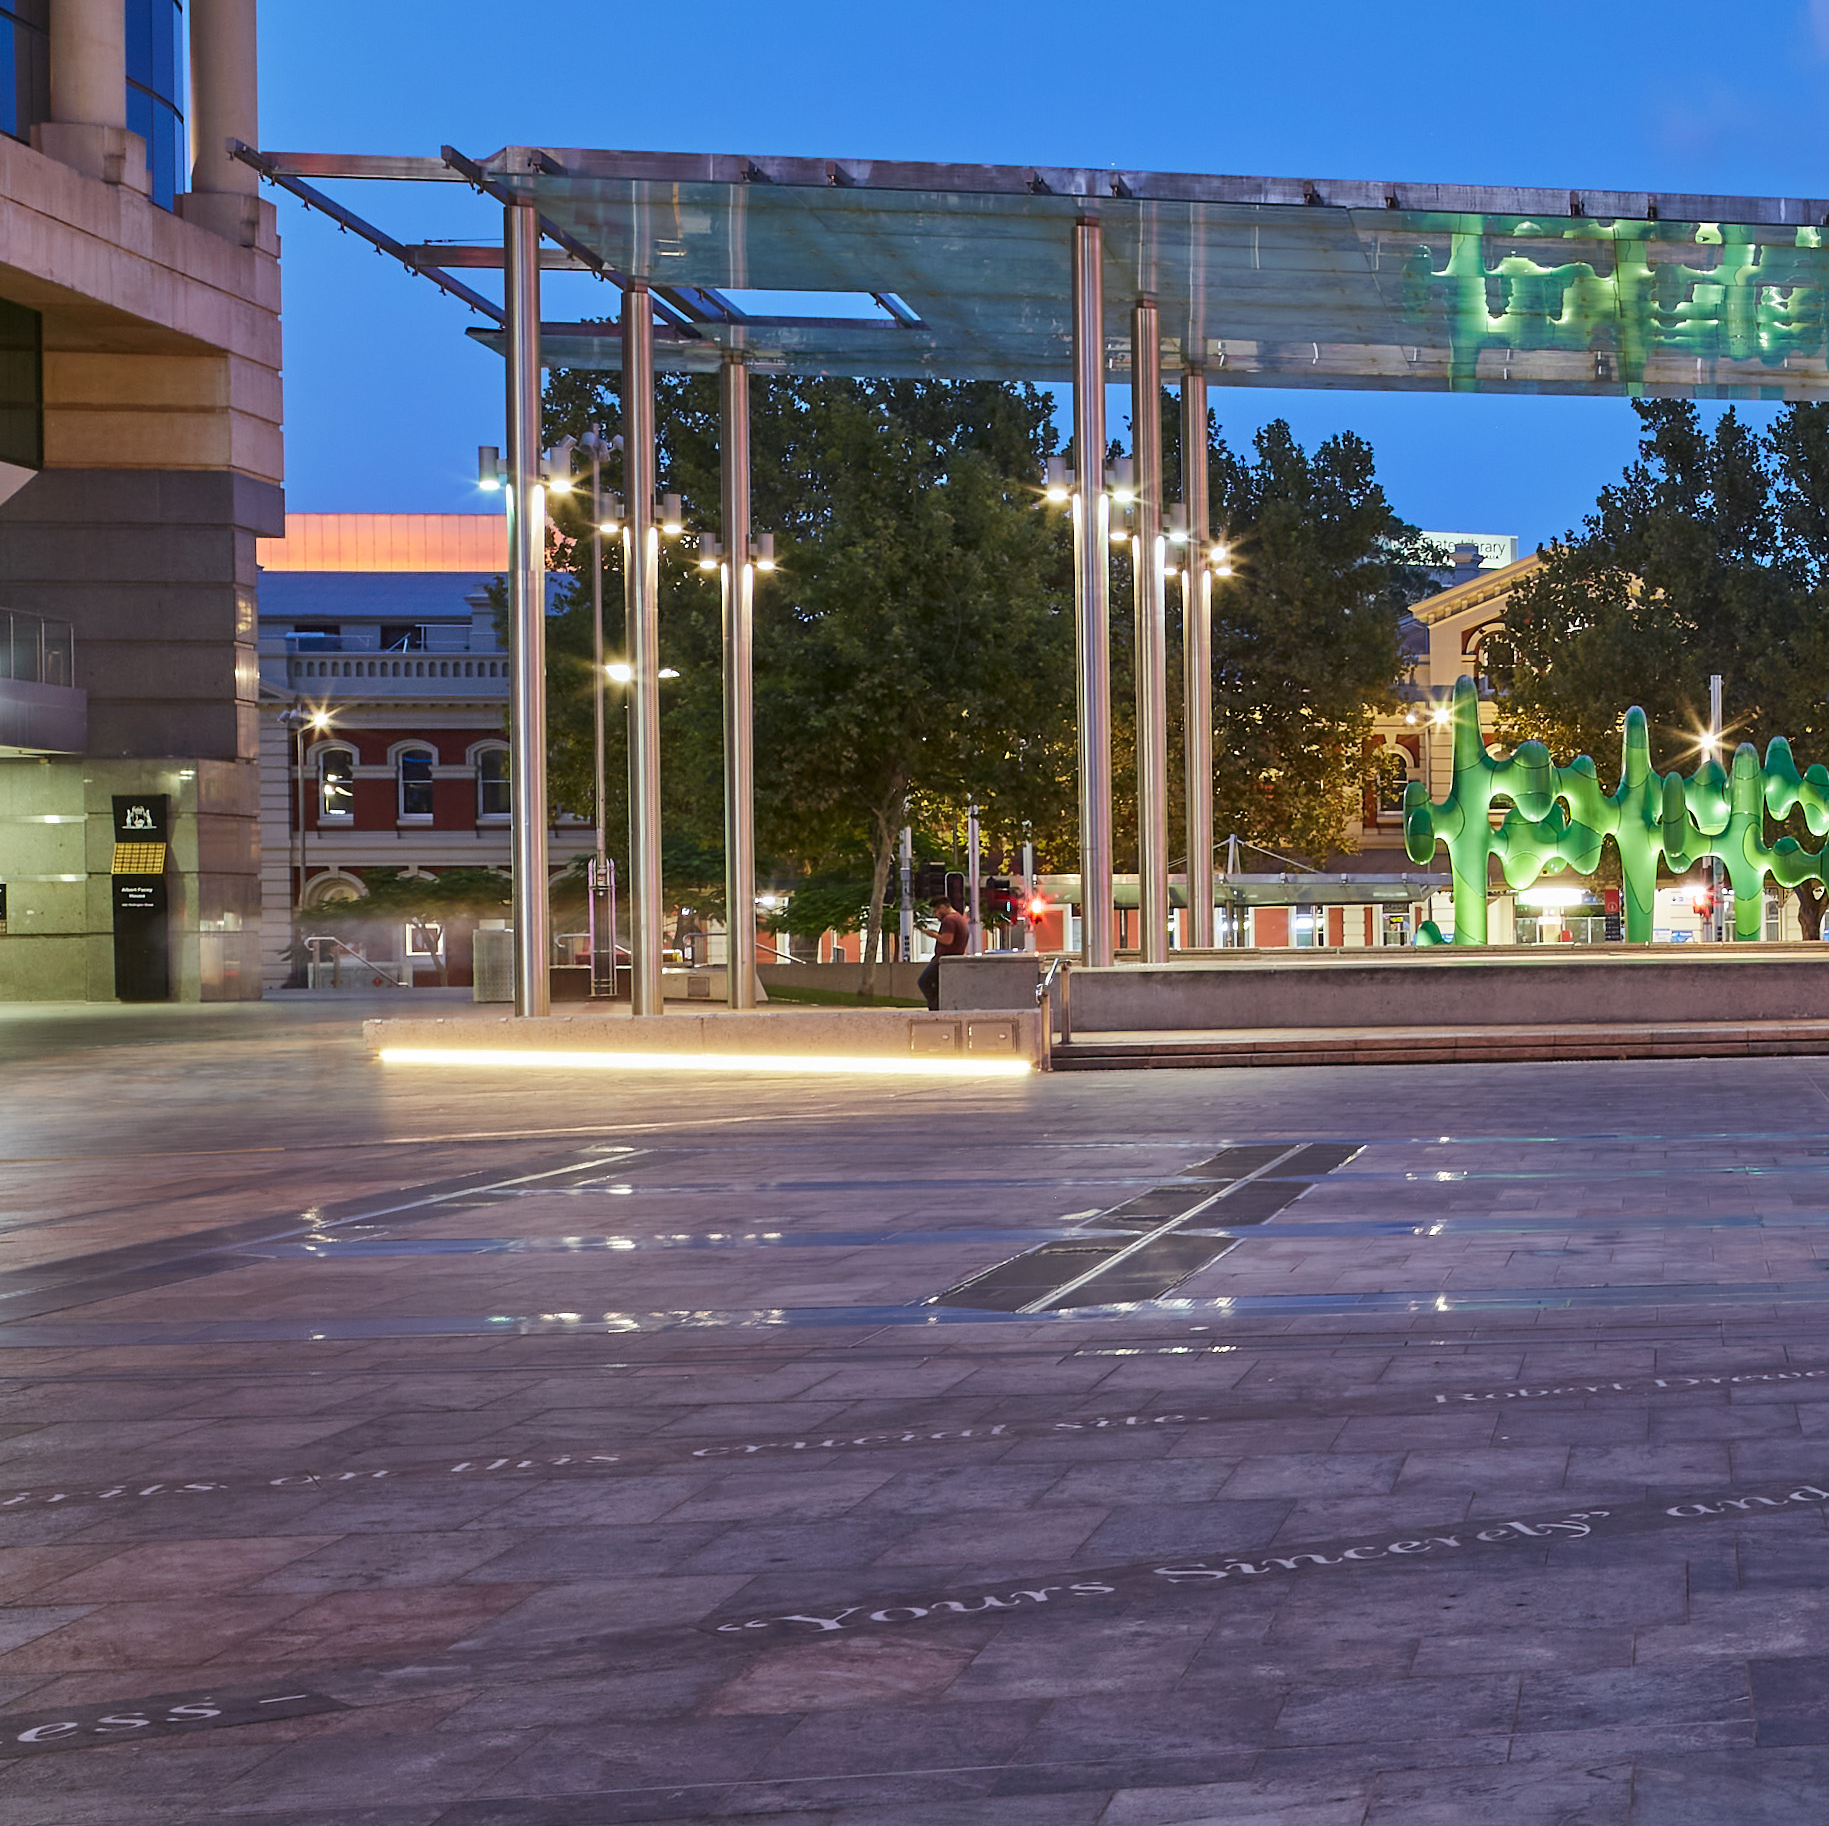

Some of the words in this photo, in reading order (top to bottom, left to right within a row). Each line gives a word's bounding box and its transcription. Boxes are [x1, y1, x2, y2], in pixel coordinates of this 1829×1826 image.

[1435, 1380, 1632, 1404] Robert
[450, 1454, 621, 1473] this
[691, 1423, 1016, 1458] crucial
